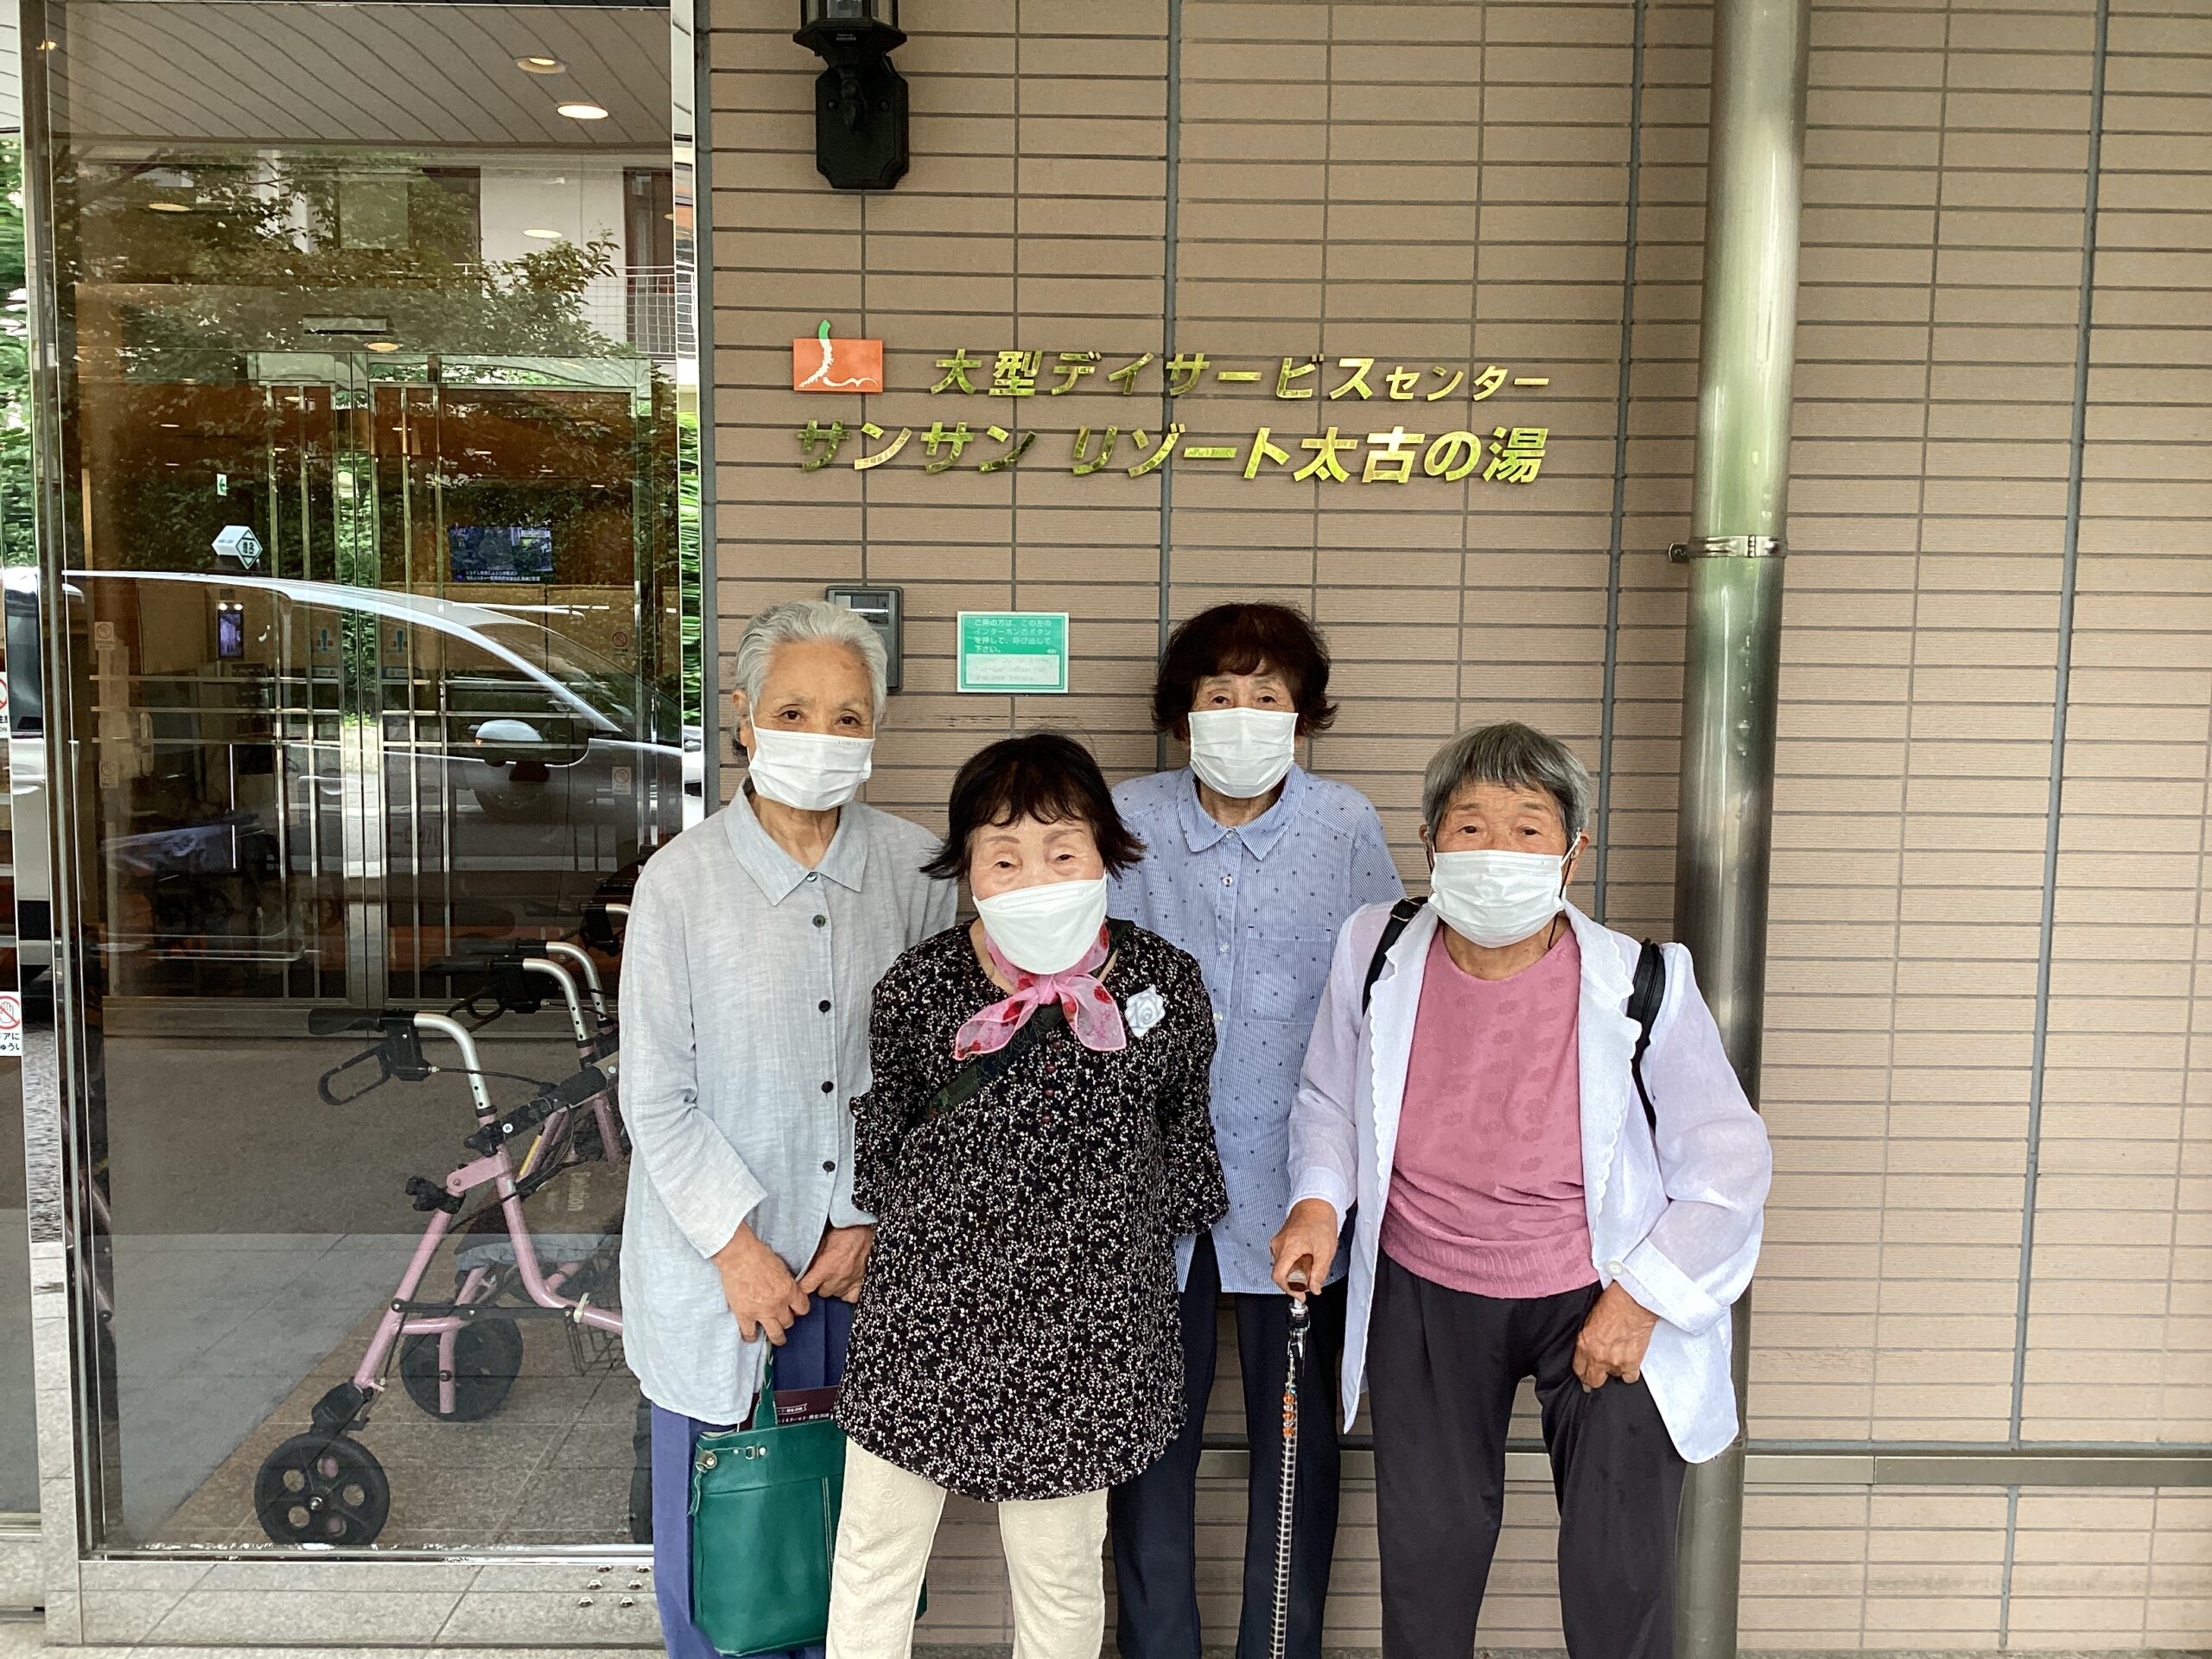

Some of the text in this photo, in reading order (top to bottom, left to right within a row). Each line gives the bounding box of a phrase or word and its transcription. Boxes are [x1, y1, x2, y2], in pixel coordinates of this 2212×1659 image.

[931, 350, 1550, 402] 大型デイサービスセンター
